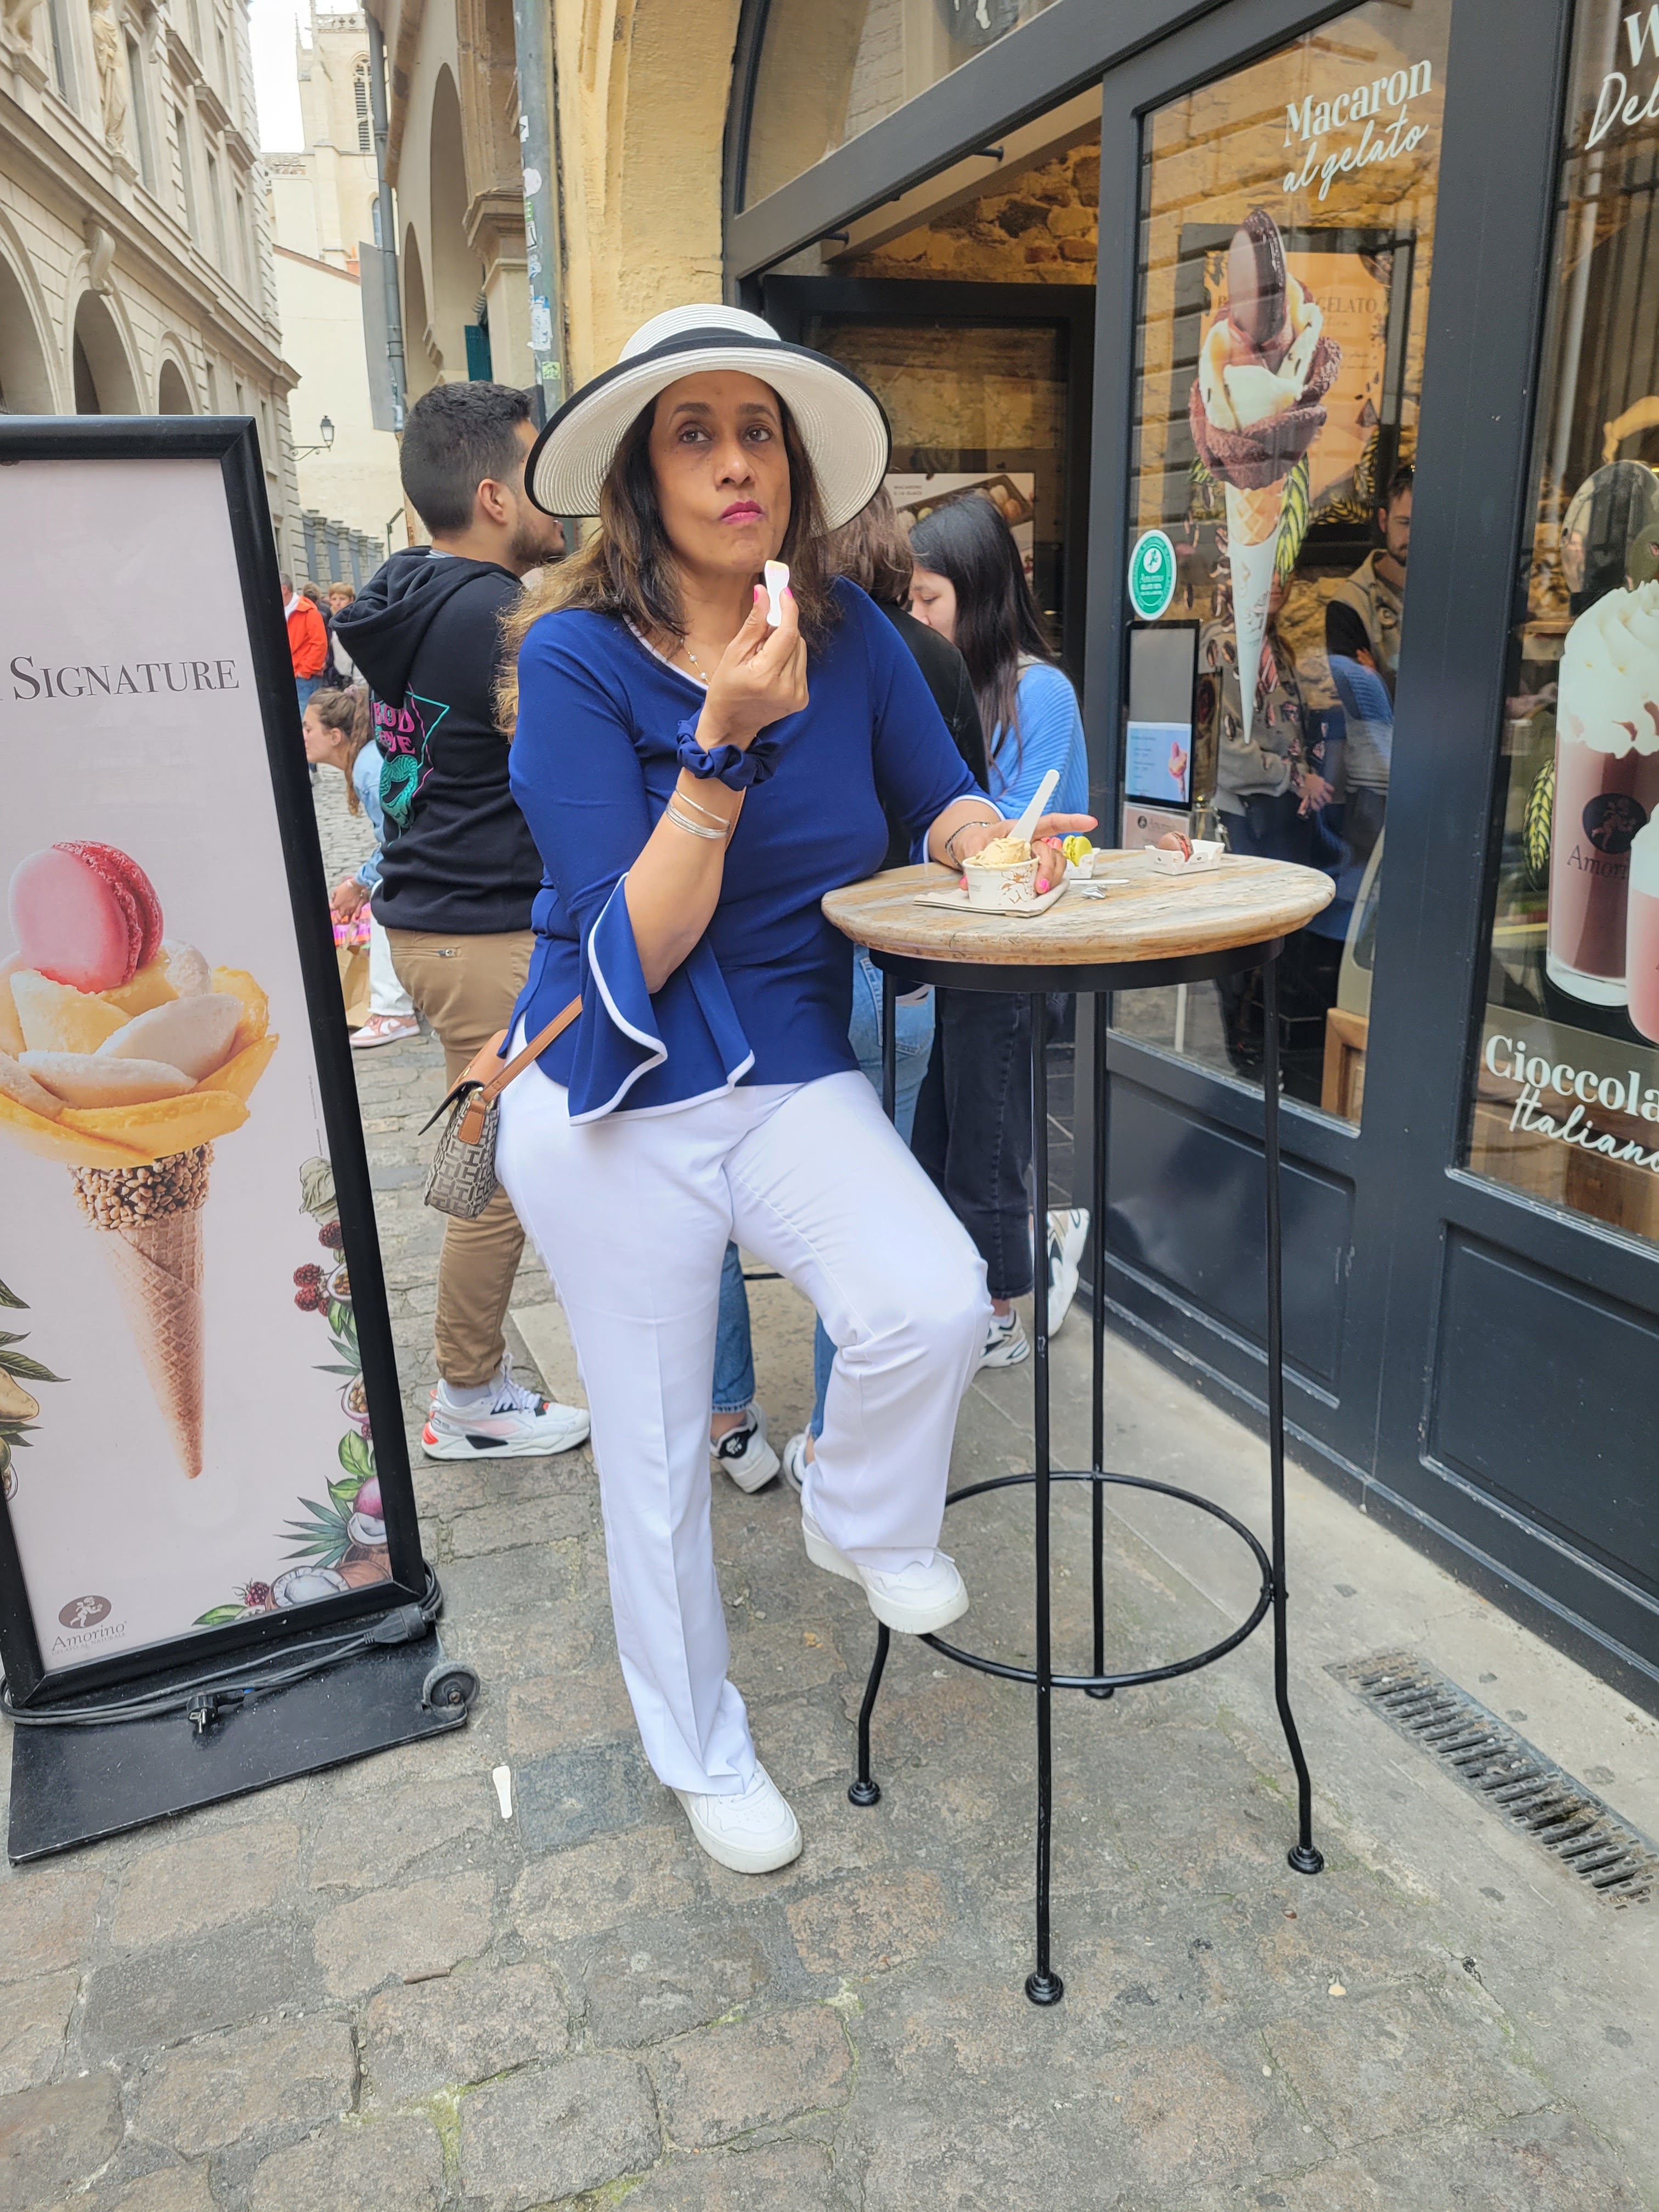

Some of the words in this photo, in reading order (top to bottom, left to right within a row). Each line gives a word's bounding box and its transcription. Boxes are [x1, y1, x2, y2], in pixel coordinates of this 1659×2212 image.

[1283, 60, 1432, 148] Macaron
[1283, 141, 1320, 192] al
[1318, 103, 1429, 201] gelato
[1316, 297, 1378, 313] GELATO
[52, 1624, 125, 1651] Amorino
